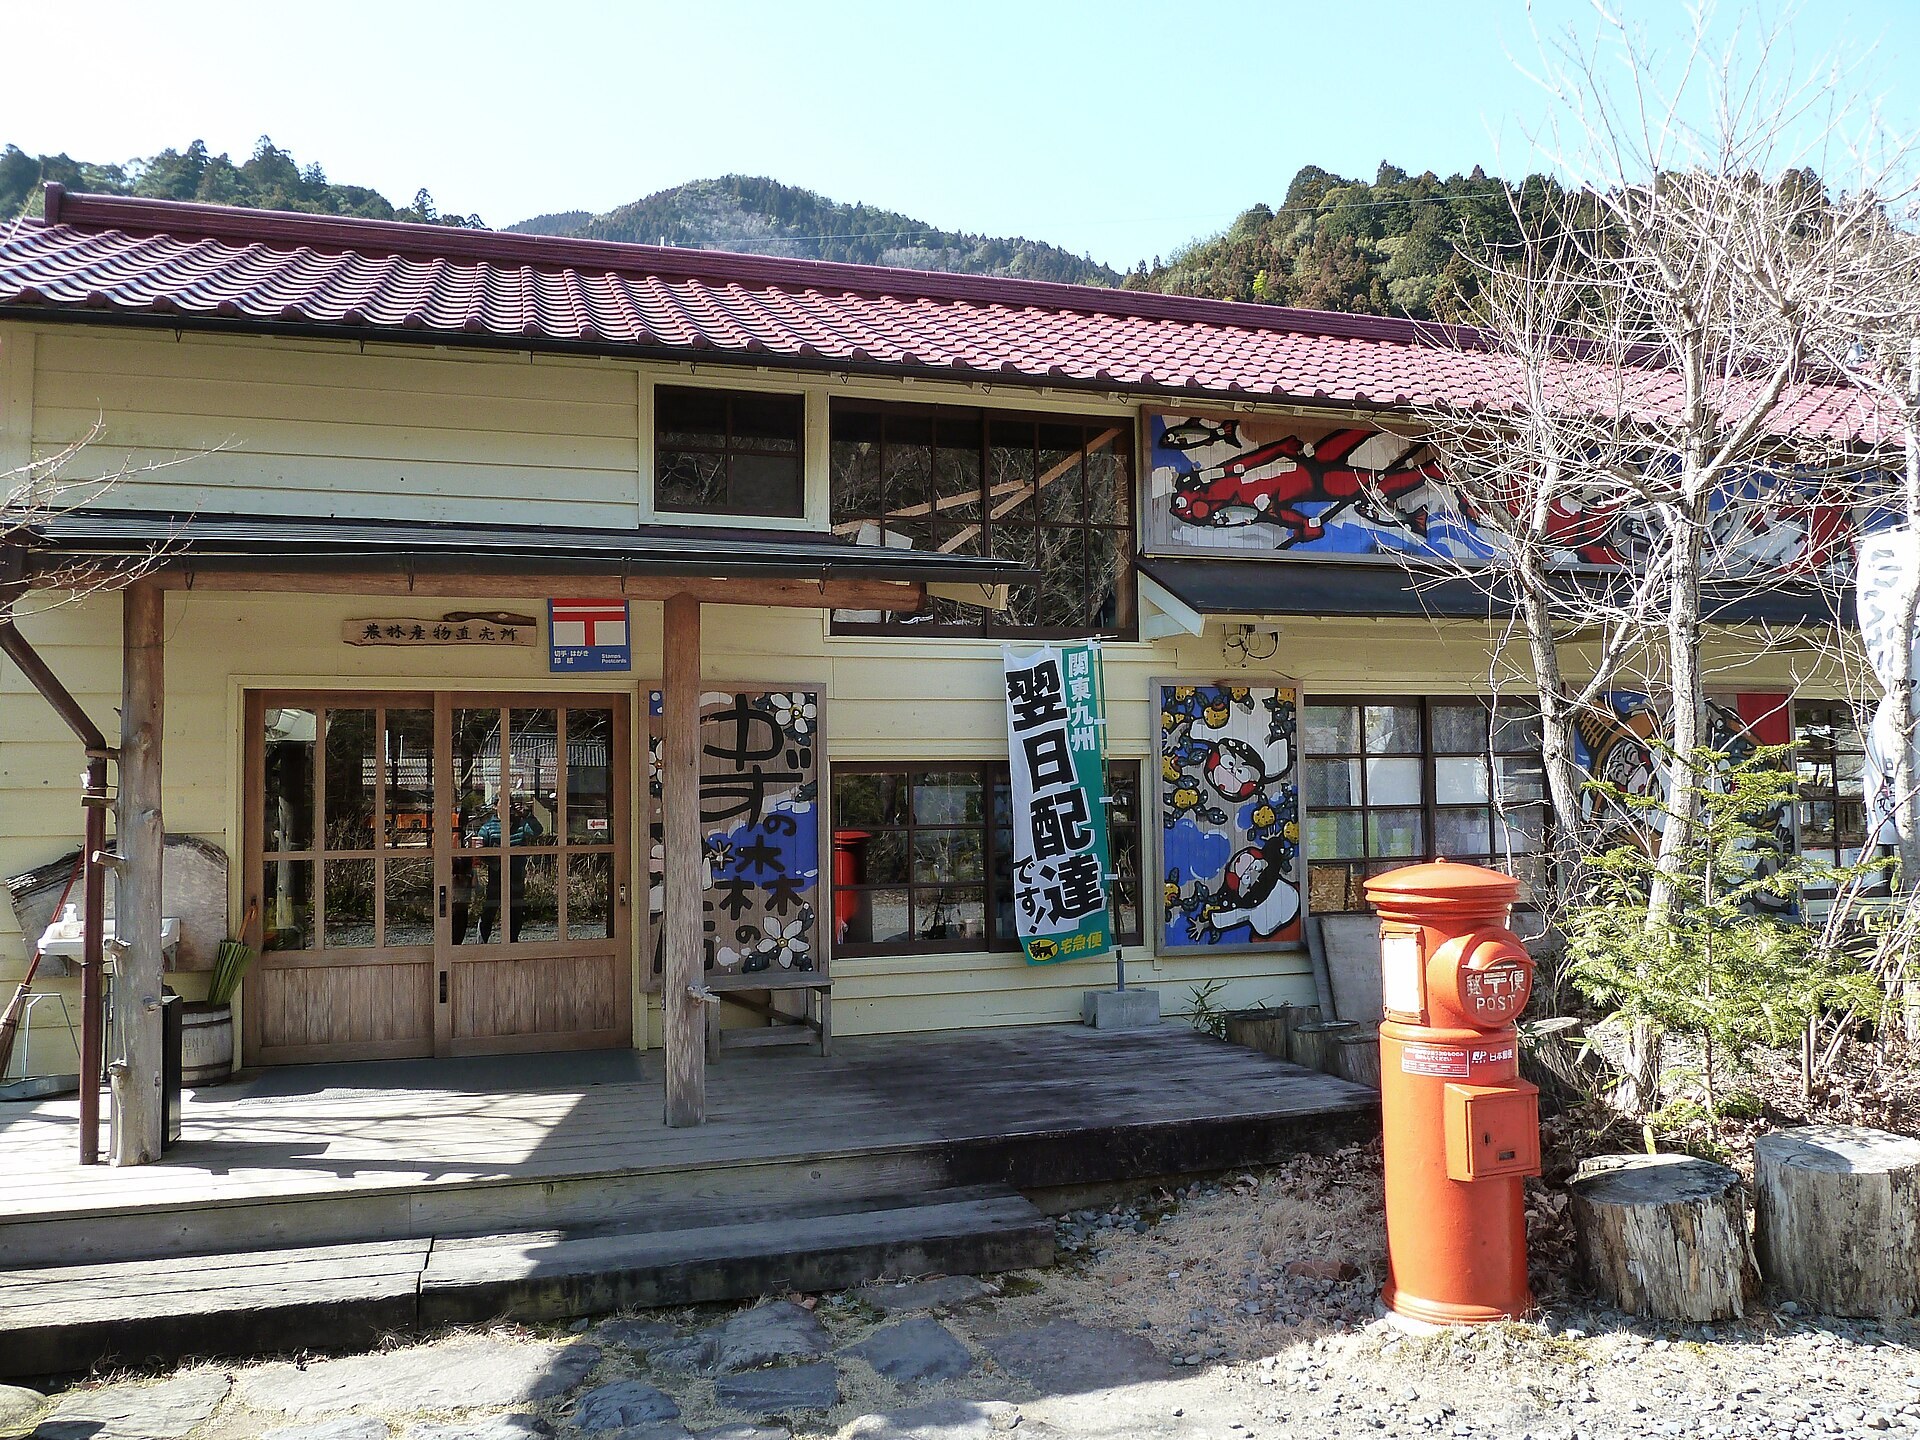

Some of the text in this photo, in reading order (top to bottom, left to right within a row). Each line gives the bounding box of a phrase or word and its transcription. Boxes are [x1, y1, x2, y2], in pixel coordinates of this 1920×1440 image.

[362, 622, 518, 642] 農林産物直売所
[1068, 652, 1095, 751] 関東九州
[1005, 659, 1103, 927] 翌日配達
[1061, 931, 1102, 954] 宅急便
[1476, 994, 1516, 1011] POST
